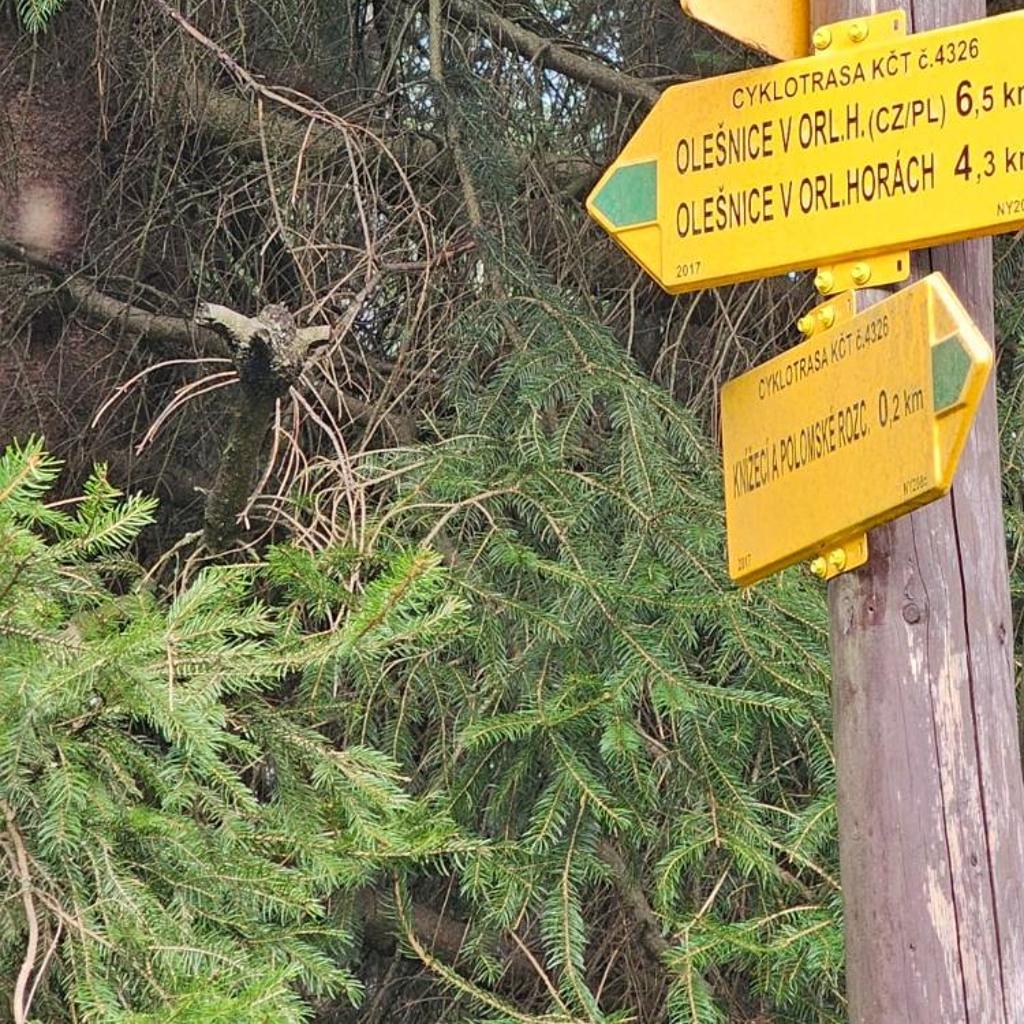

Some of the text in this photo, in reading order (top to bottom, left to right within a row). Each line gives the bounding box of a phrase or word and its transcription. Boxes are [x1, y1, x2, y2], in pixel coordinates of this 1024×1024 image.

[732, 62, 865, 109] CYKLOTRASA
[872, 50, 911, 79] KČT
[676, 120, 773, 175] OLEŠNICE
[779, 116, 792, 153] V
[956, 80, 994, 119] 6,5
[676, 184, 774, 238] OLEŠNICE
[780, 180, 793, 218] V
[954, 144, 996, 184] 4,3
[676, 261, 701, 278] 2017
[758, 347, 828, 400] CYKLOTRASA
[831, 333, 852, 362] KČT
[733, 438, 770, 499] KNÍŽECÍ
[772, 443, 779, 480] A
[781, 405, 836, 476] POLOMSKÉ
[879, 389, 900, 428] 0,2
[904, 388, 924, 416] km
